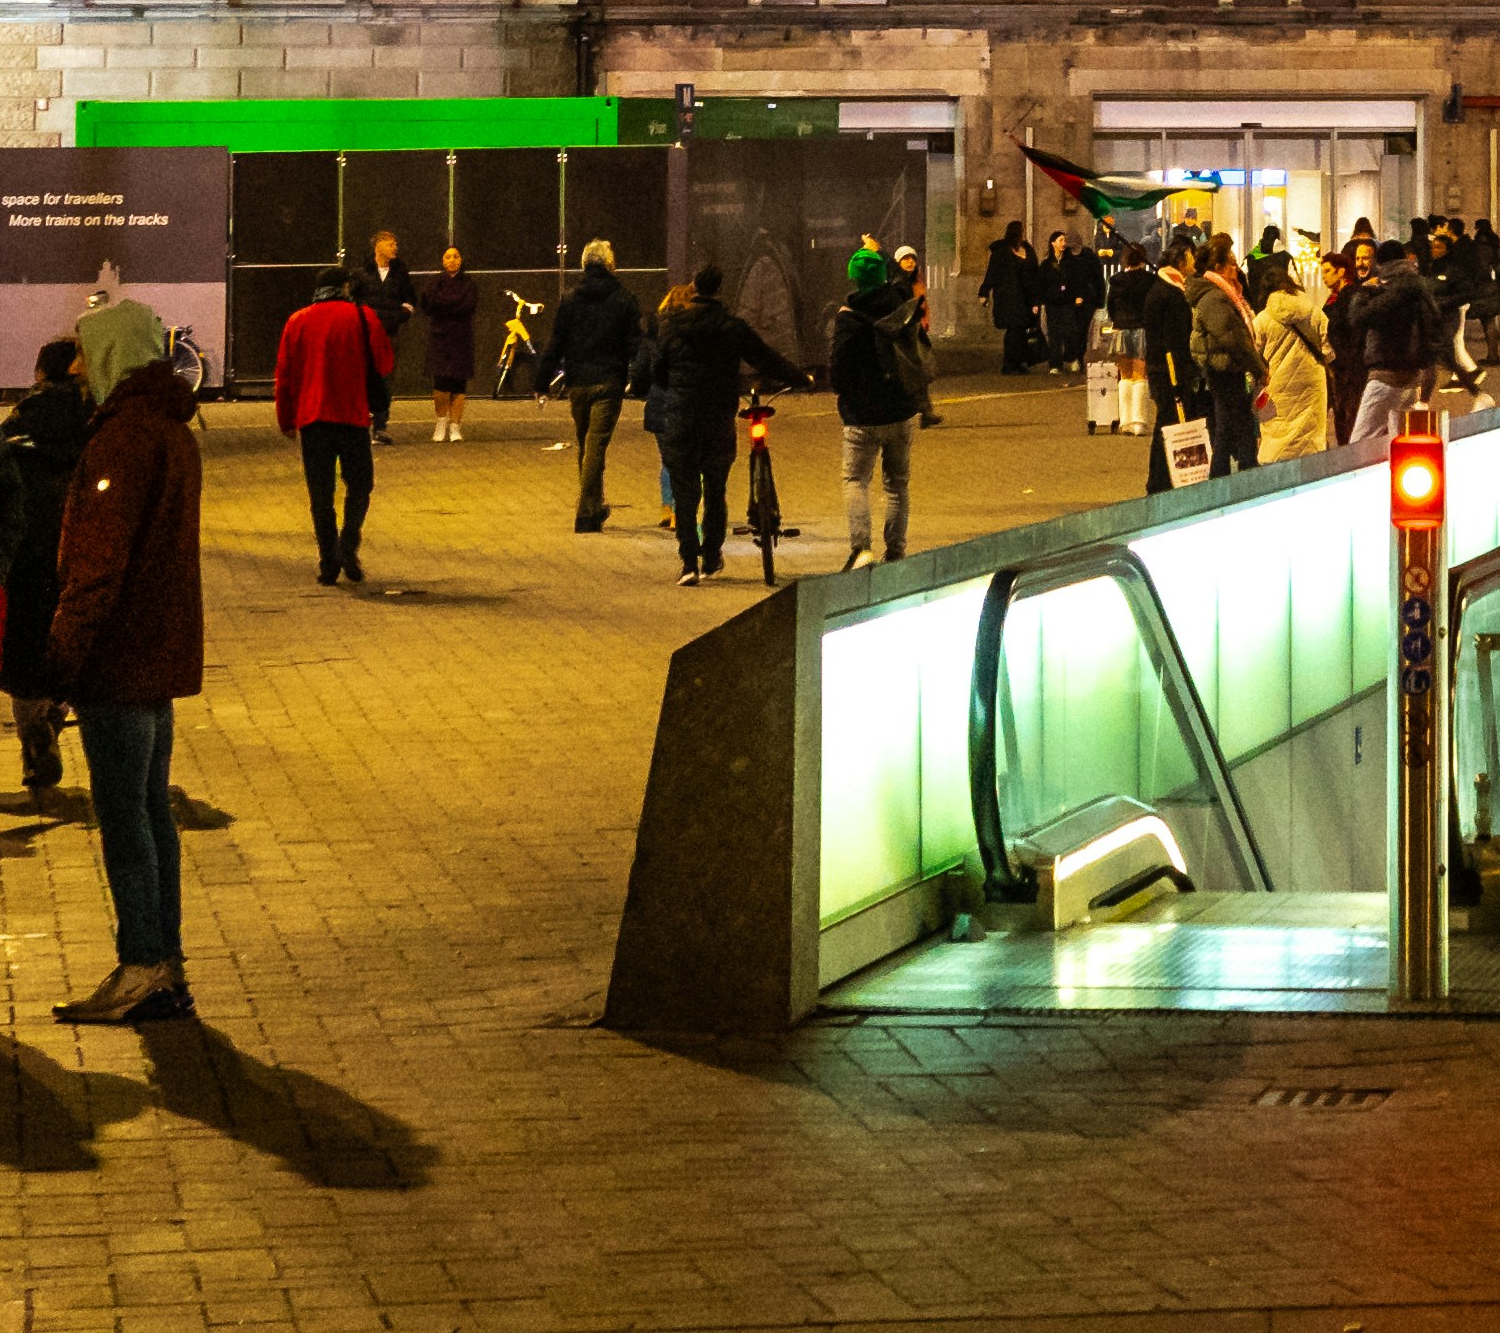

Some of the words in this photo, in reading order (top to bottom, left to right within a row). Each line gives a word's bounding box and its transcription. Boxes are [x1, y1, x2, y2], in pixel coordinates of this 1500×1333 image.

[2, 196, 40, 208] space
[43, 193, 62, 205] for
[64, 193, 123, 204] travellers
[9, 215, 42, 226] More
[46, 215, 81, 226] trains
[84, 217, 100, 226] on
[104, 214, 125, 225] the
[128, 213, 168, 225] tracks
